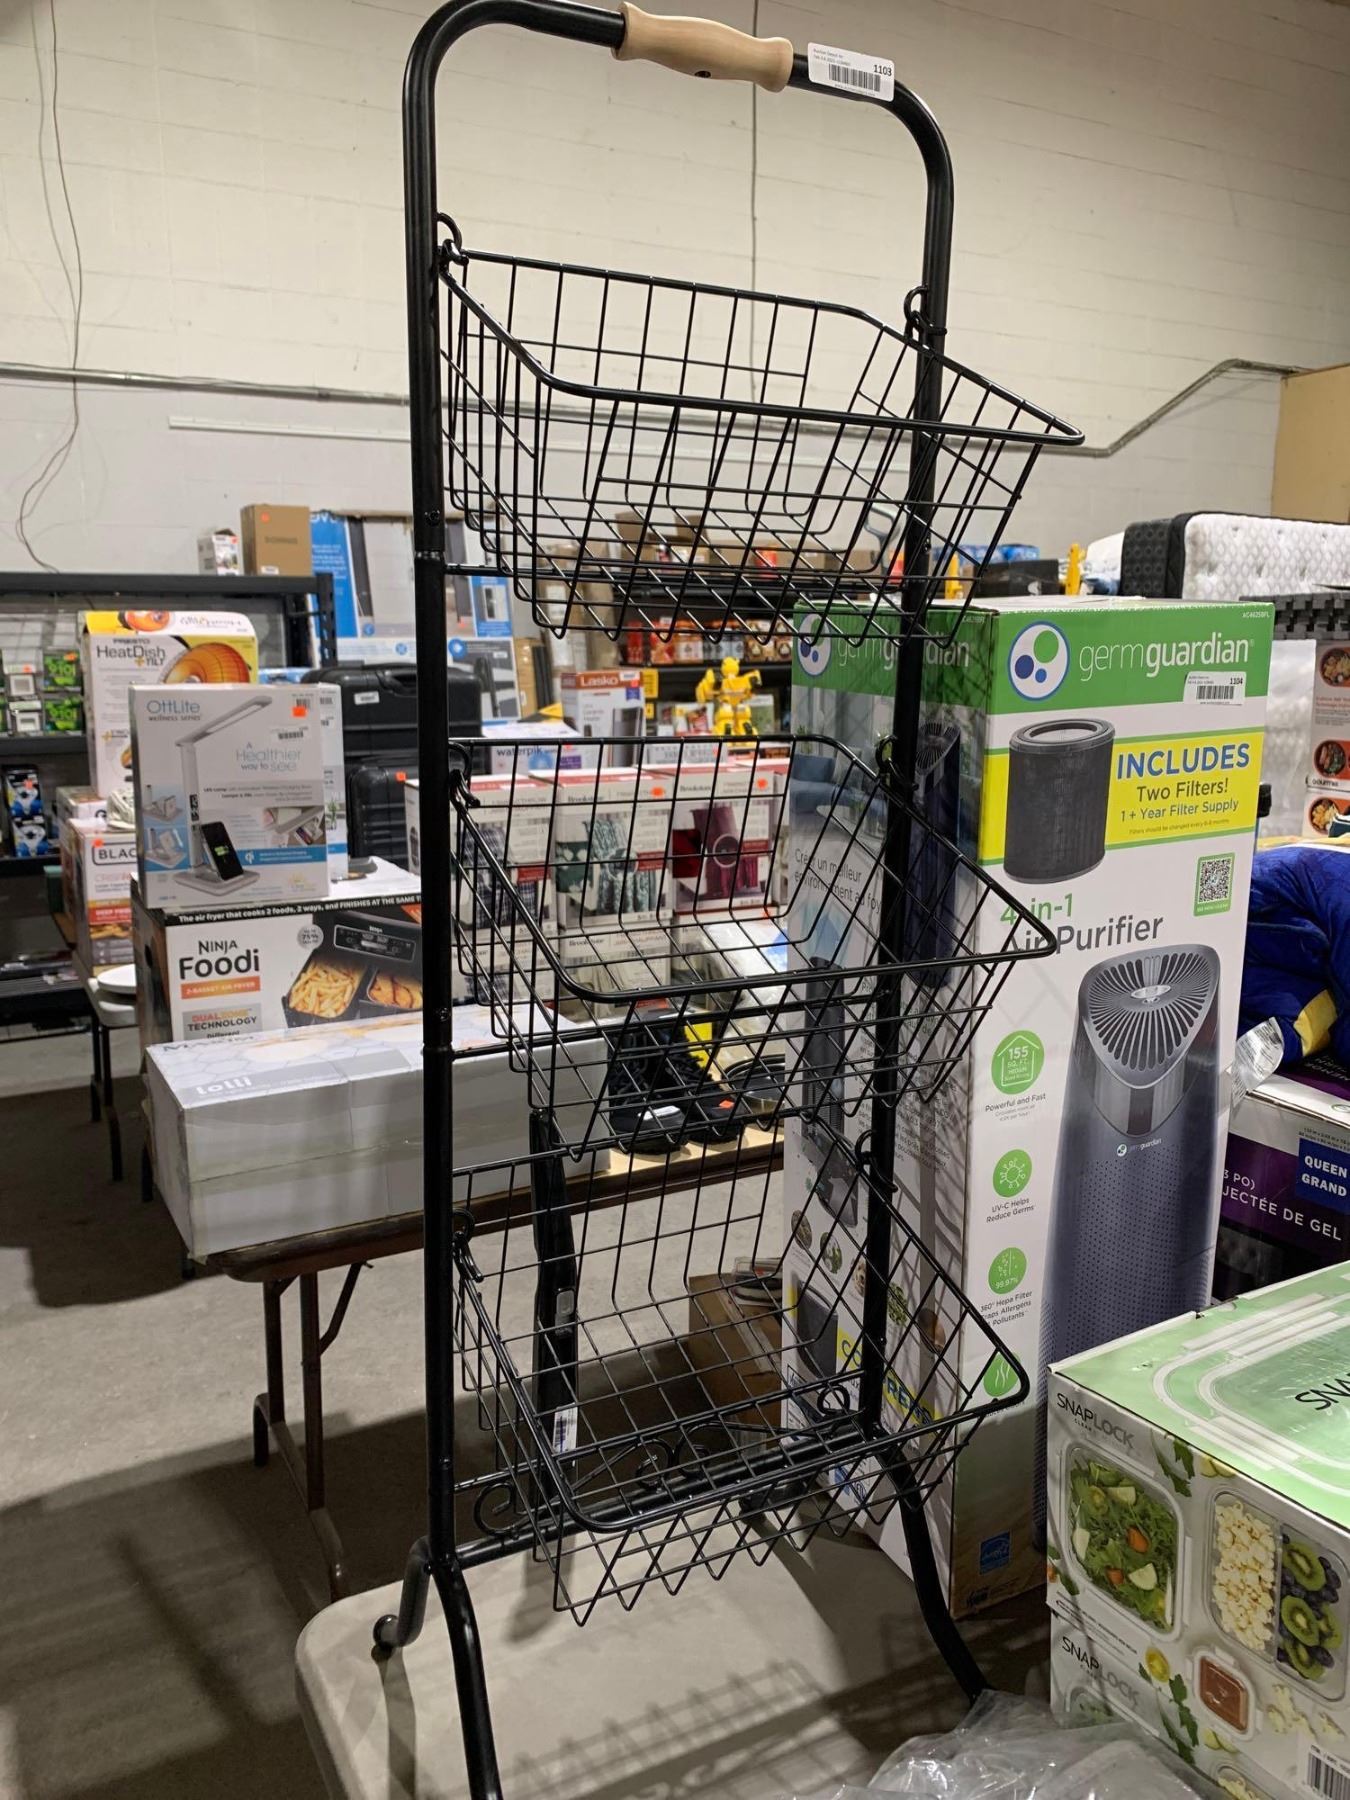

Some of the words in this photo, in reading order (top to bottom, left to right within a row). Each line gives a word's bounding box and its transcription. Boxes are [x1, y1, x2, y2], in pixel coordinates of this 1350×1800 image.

[873, 64, 892, 77] 1103
[96, 646, 166, 659] HeatDish
[837, 632, 970, 671] germgdian
[1078, 631, 1249, 682] germguardian
[580, 673, 618, 687] Lasko
[1229, 676, 1243, 685] 1104
[146, 699, 201, 715] OttLite
[236, 750, 302, 762] Healthier
[1117, 743, 1250, 780] INCLUDES
[241, 762, 258, 771] way
[260, 761, 269, 770] to
[271, 761, 297, 772] see
[1137, 785, 1171, 802] Two
[1176, 777, 1229, 798] Filters!
[1120, 810, 1126, 823] 1
[1140, 806, 1167, 820] Year
[1169, 802, 1199, 817] Filter
[1202, 798, 1239, 813] Supply
[98, 847, 137, 860] BLAC
[829, 862, 862, 881] milleur
[178, 914, 194, 923] The
[206, 912, 225, 922] fryer
[226, 911, 242, 920] that
[243, 908, 266, 918] cooks
[325, 902, 339, 910] and
[339, 900, 371, 909] FINISHES
[371, 899, 381, 907] AT
[381, 897, 393, 906] THE
[393, 895, 416, 904] SAME
[1000, 893, 1073, 925] 4in-1
[1056, 915, 1164, 955] Purifier
[198, 939, 238, 955] NINJA
[178, 949, 260, 980] Foodi
[187, 1016, 257, 1031] TECHNOLOGY
[1008, 1046, 1029, 1060] 155
[985, 1100, 1016, 1112] Powerful
[1016, 1096, 1030, 1105] and
[1031, 1092, 1046, 1101] Fast
[1304, 1155, 1348, 1179] QUEEN
[1233, 1174, 1256, 1191] PO)
[1301, 1173, 1347, 1197] GRAND
[986, 1211, 1012, 1223] Reduce
[1012, 1205, 1034, 1216] Germs
[991, 1202, 1010, 1213] UV-C
[1011, 1198, 1030, 1207] Helps
[1283, 1208, 1303, 1226] DE
[1309, 1218, 1342, 1241] GEL
[995, 1296, 1014, 1307] Hepa
[1014, 1290, 1033, 1301] Filter
[1000, 1301, 1032, 1314] Allergens
[992, 1311, 1025, 1326] Pollutants
[1057, 1392, 1135, 1450] SNAPLOCK
[1062, 1636, 1140, 1706] SNAPLOCK
